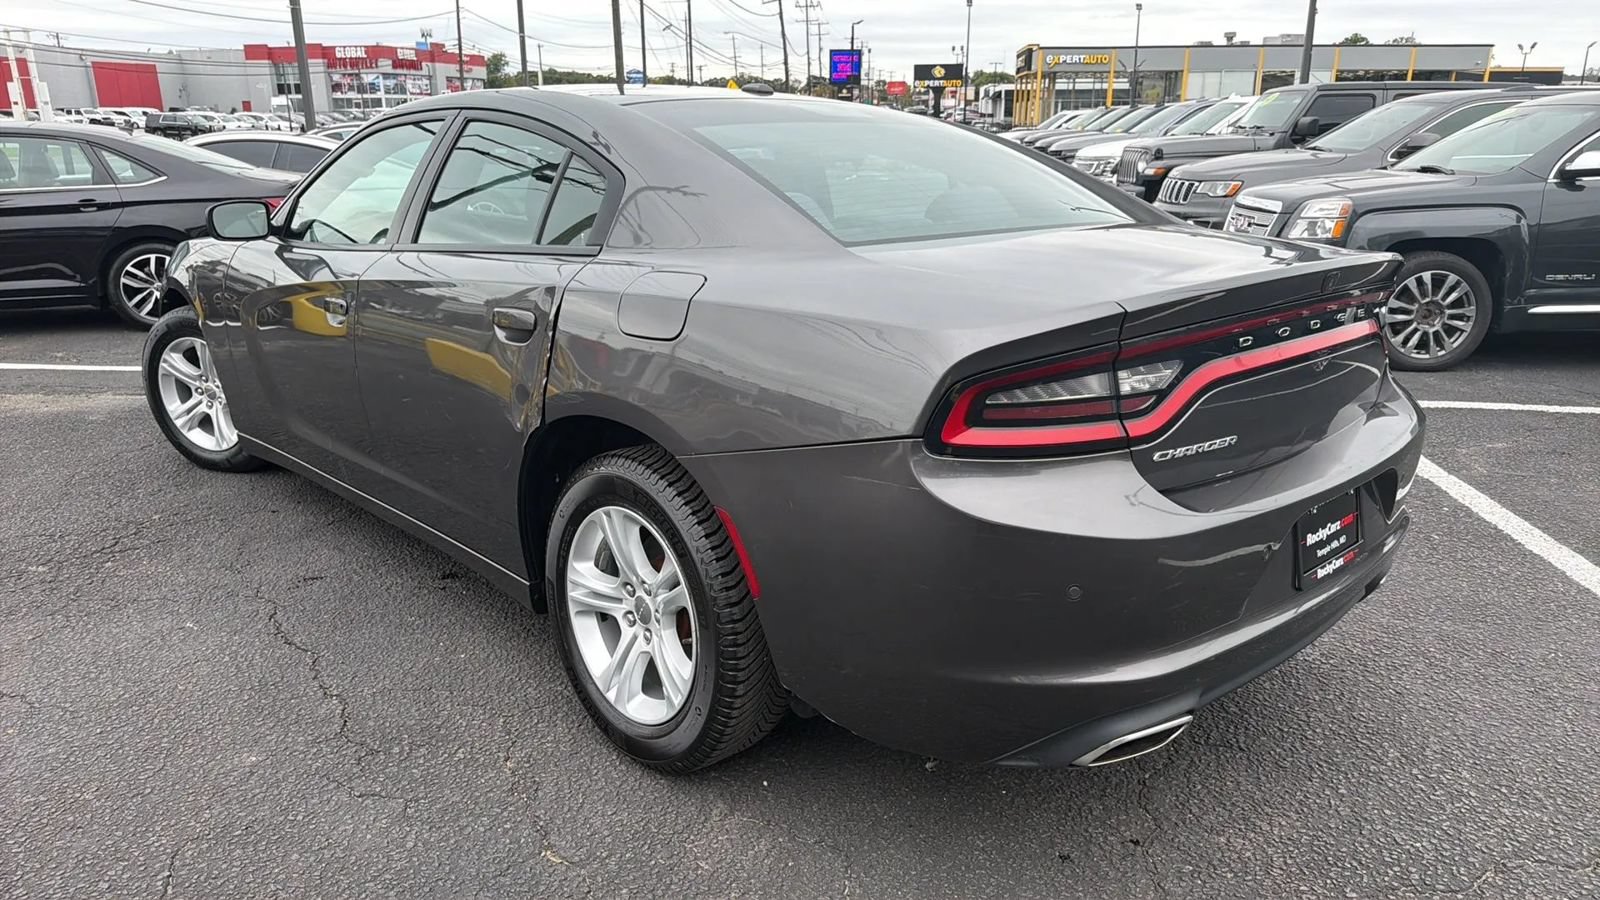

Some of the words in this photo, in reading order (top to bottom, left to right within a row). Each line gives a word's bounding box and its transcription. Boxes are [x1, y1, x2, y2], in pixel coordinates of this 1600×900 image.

[335, 46, 367, 59] GLOBAL
[1545, 273, 1596, 281] DENALI
[1238, 308, 1366, 348] DODGE
[1152, 435, 1238, 462] CHARGER
